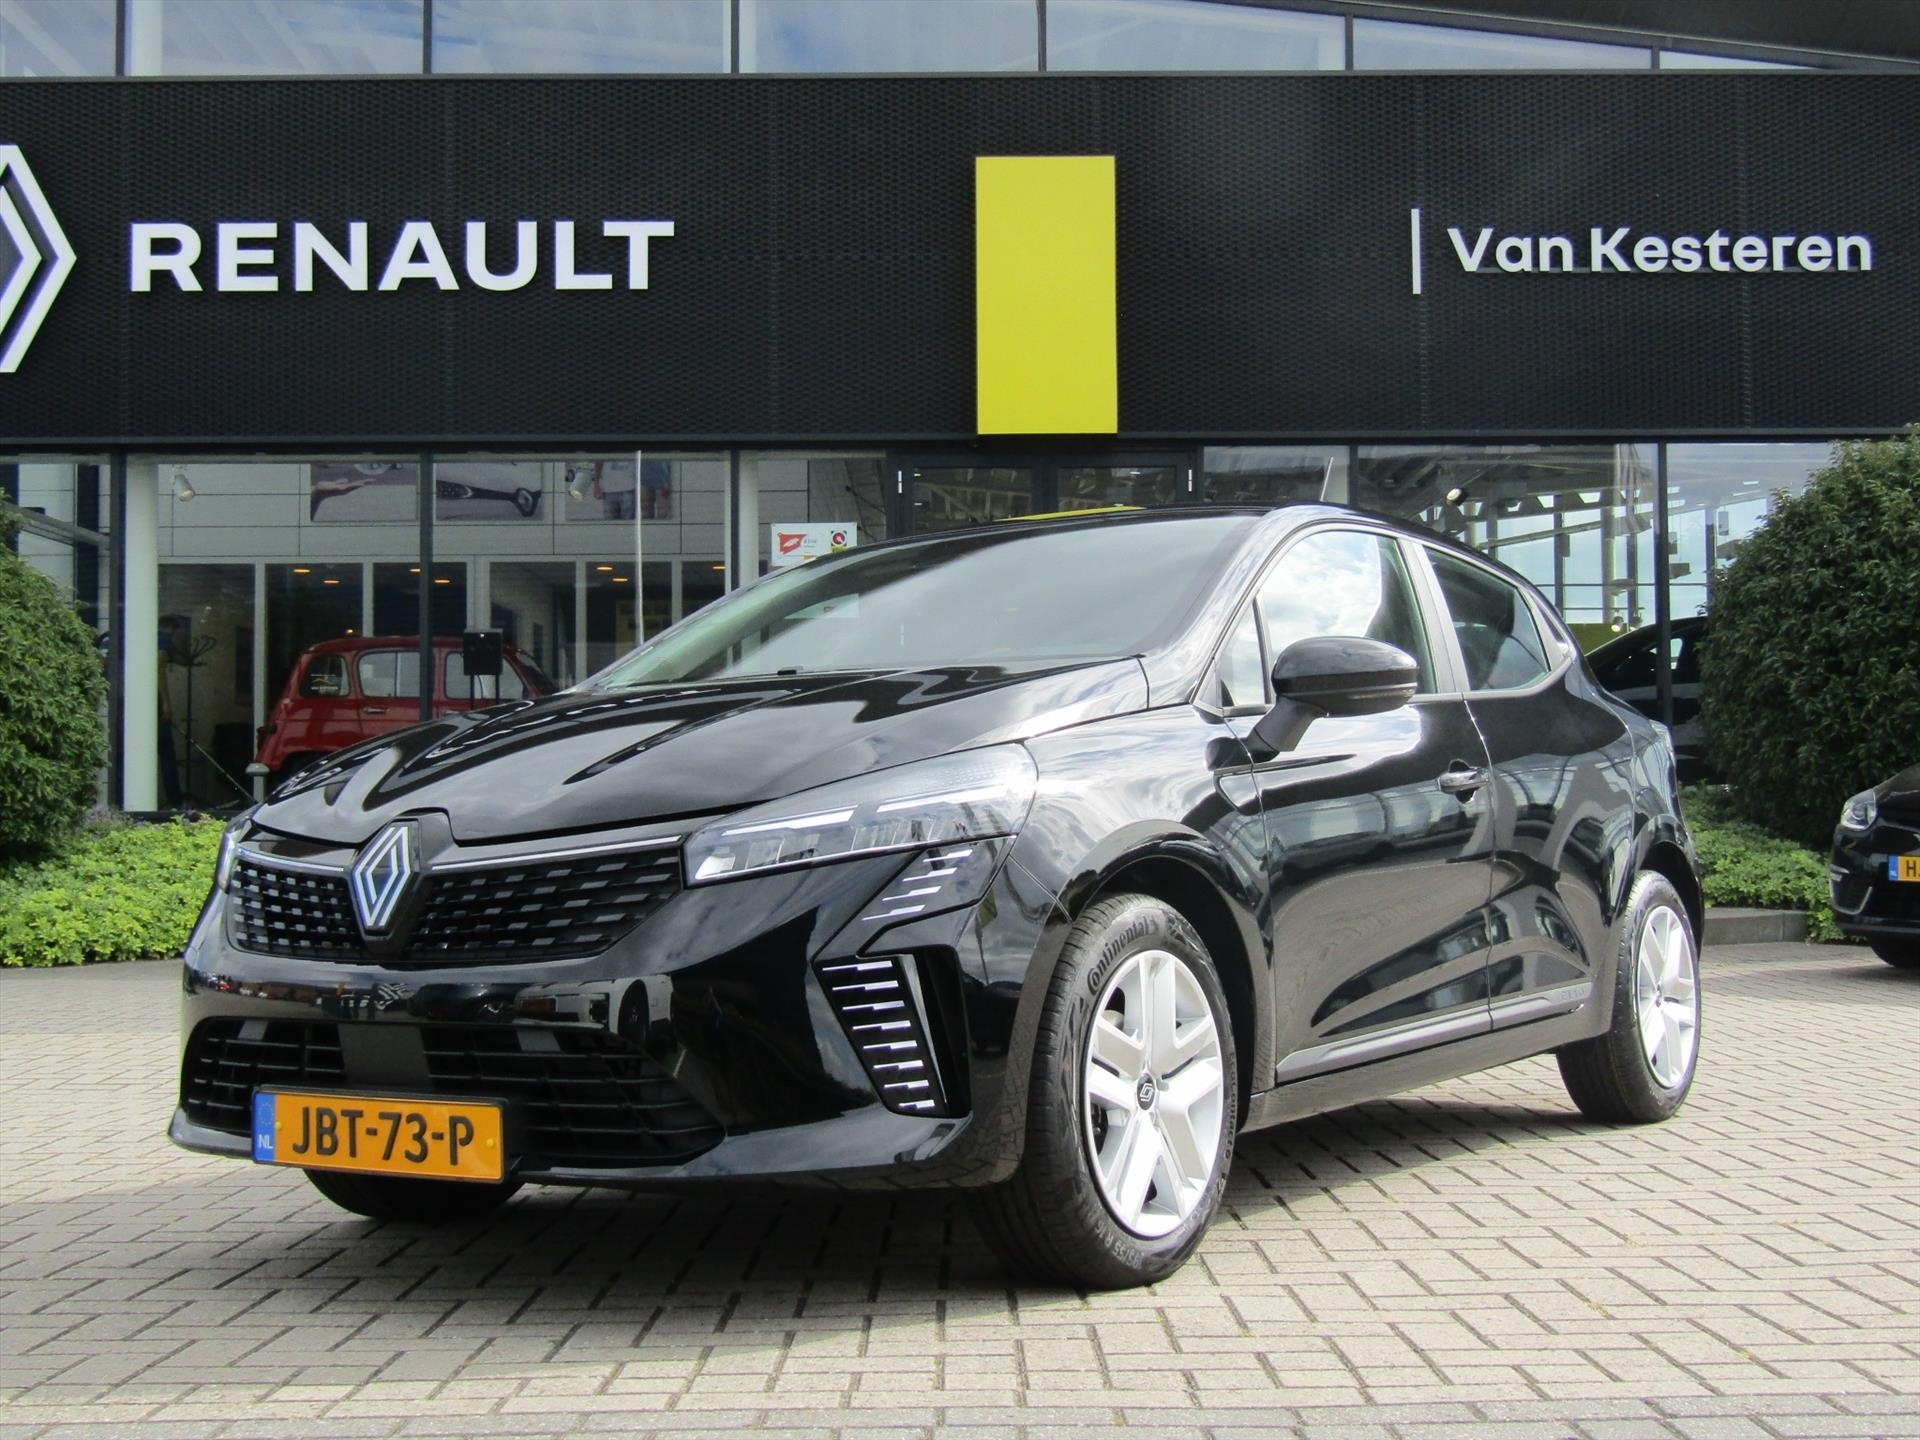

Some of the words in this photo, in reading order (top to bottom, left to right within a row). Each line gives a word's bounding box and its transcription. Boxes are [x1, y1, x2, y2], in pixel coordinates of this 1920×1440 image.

[129, 221, 675, 292] RENAULT
[1447, 227, 1574, 273] Van
[1590, 227, 1873, 273] Kesteren
[1906, 859, 1920, 878] H
[1087, 915, 1150, 996] Continental
[258, 1133, 274, 1150] NL
[292, 1106, 475, 1166] JBT-73-P
